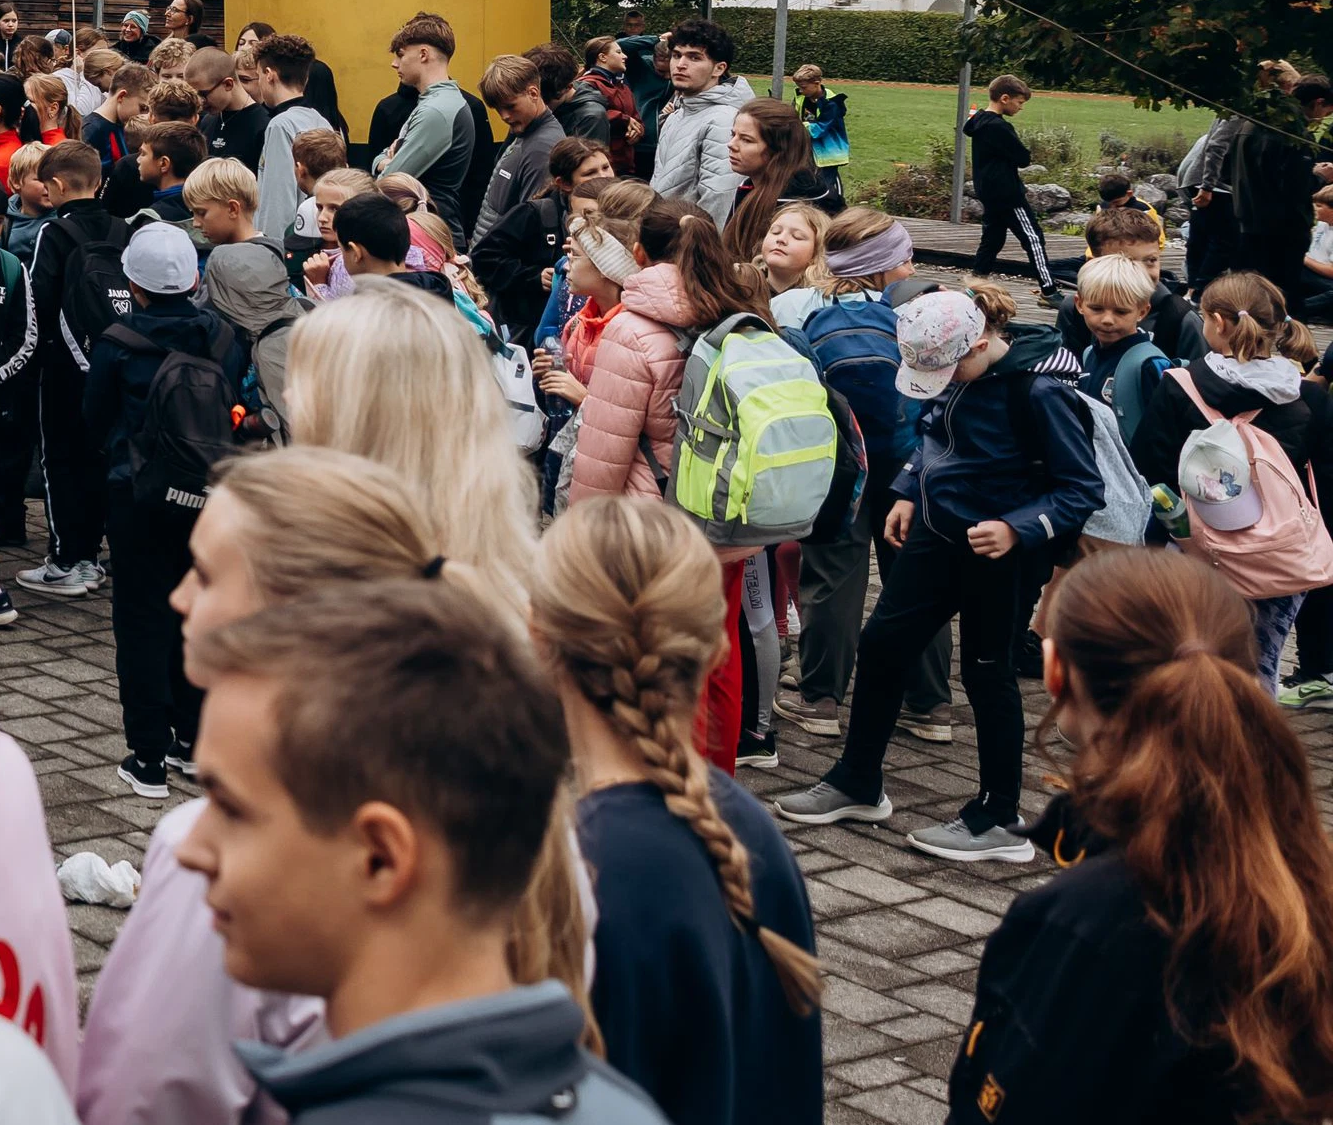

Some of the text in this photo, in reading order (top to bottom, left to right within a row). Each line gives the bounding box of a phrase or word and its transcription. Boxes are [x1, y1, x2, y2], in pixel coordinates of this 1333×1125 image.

[108, 288, 131, 298] JAKO
[165, 486, 207, 509] PUM
[744, 569, 763, 610] TEAM
